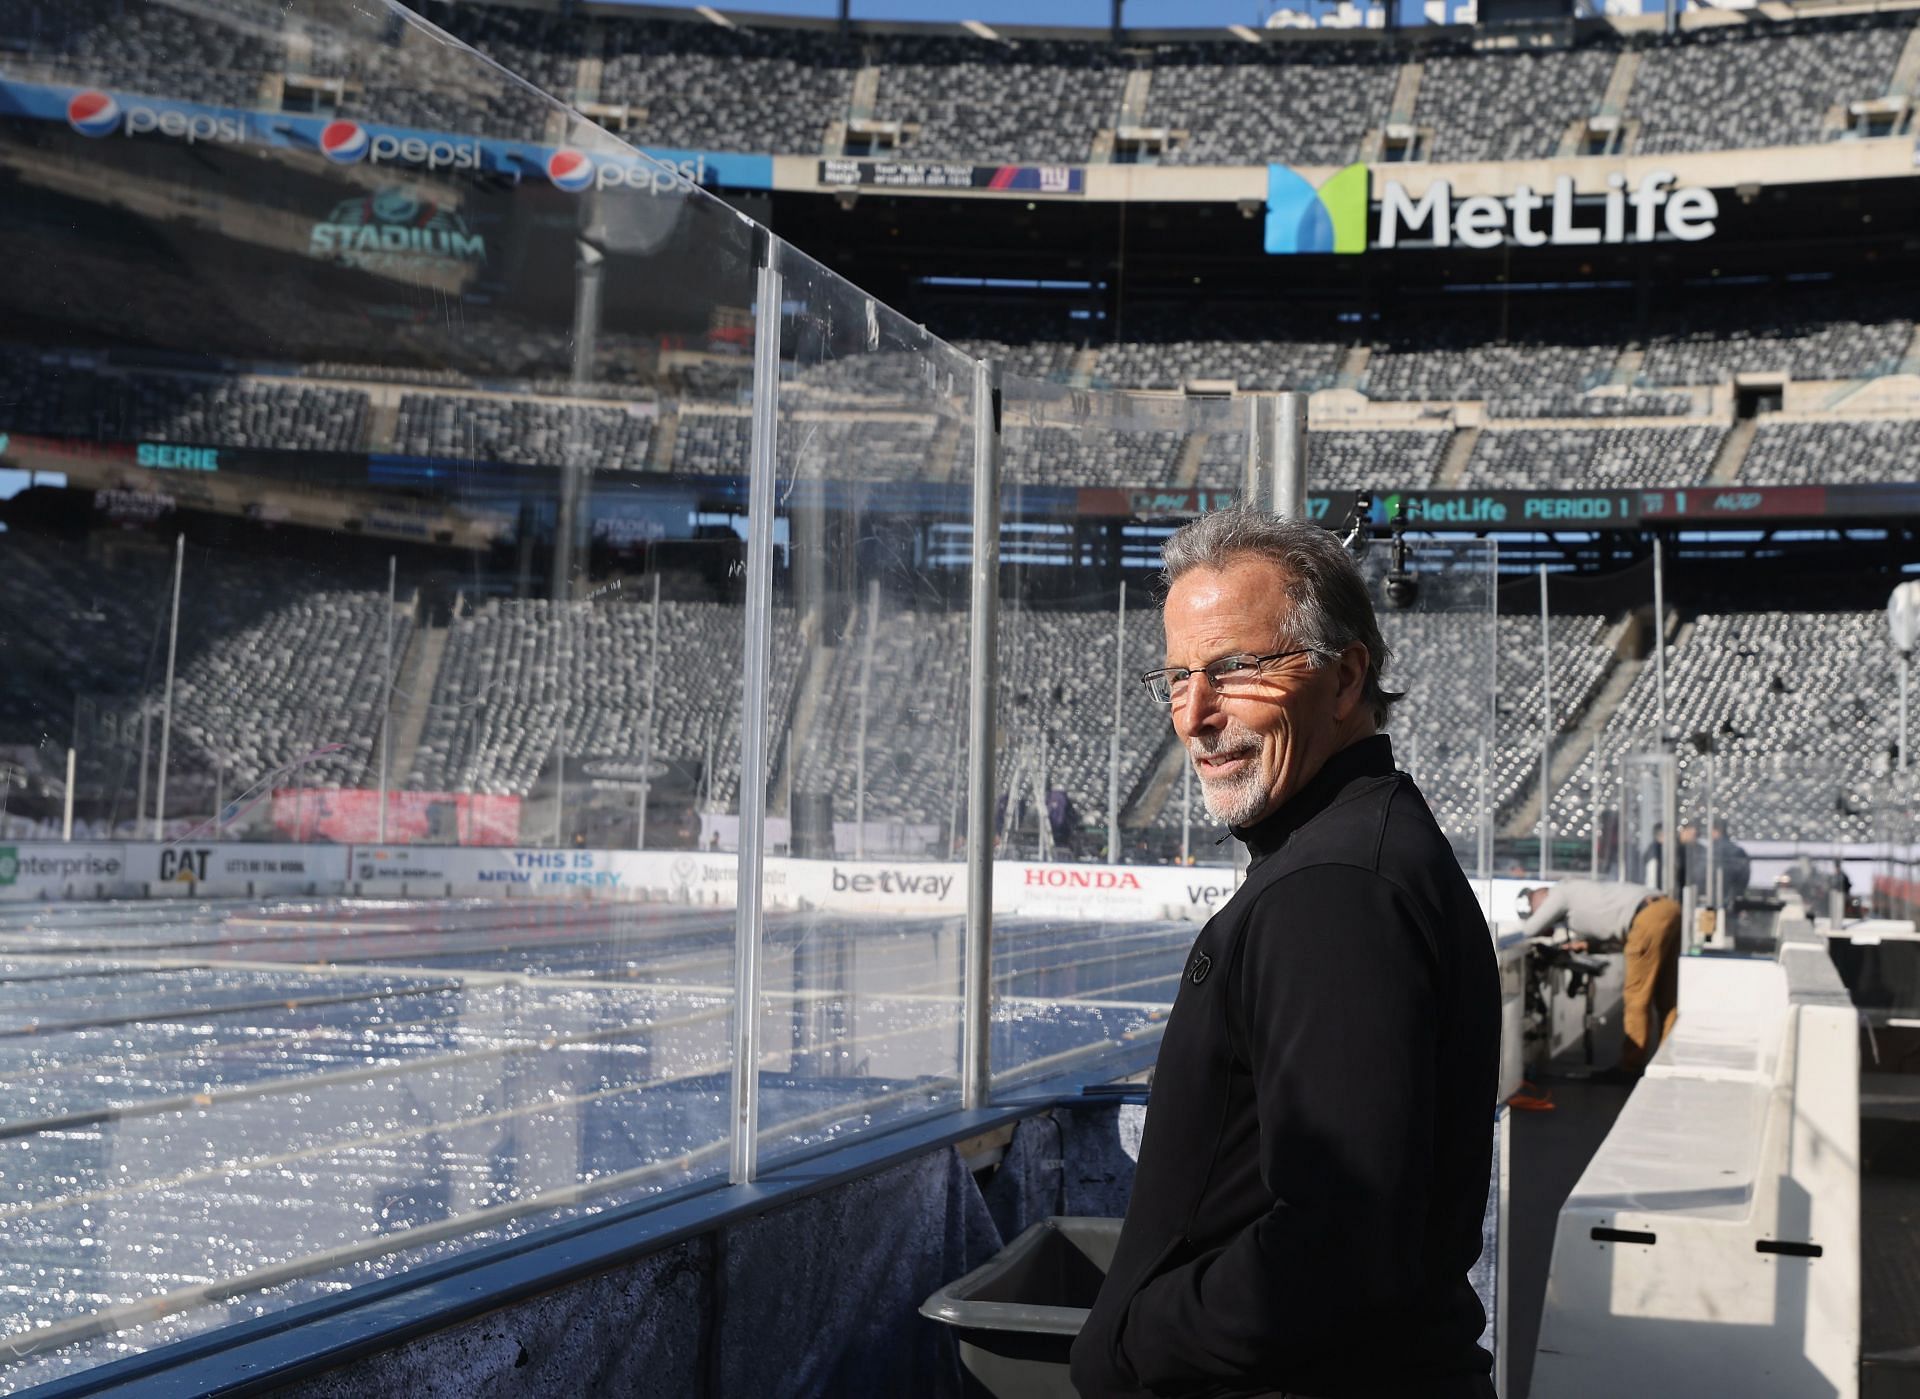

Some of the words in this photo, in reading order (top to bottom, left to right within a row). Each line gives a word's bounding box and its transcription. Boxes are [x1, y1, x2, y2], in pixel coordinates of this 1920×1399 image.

[124, 105, 246, 144] pepsi
[369, 134, 481, 169] pepsi
[595, 154, 706, 196] pepsi
[1378, 170, 1719, 248] MetLife
[309, 222, 487, 262] STADIUM
[136, 443, 218, 471] SERIE
[1525, 499, 1611, 520] PERIOD
[1620, 497, 1628, 518] 1
[160, 850, 211, 881] CAT
[478, 870, 530, 883] NEW
[514, 853, 566, 868] THIS
[574, 853, 593, 868] IS
[833, 867, 953, 901] betway
[1024, 868, 1141, 889] HONDA
